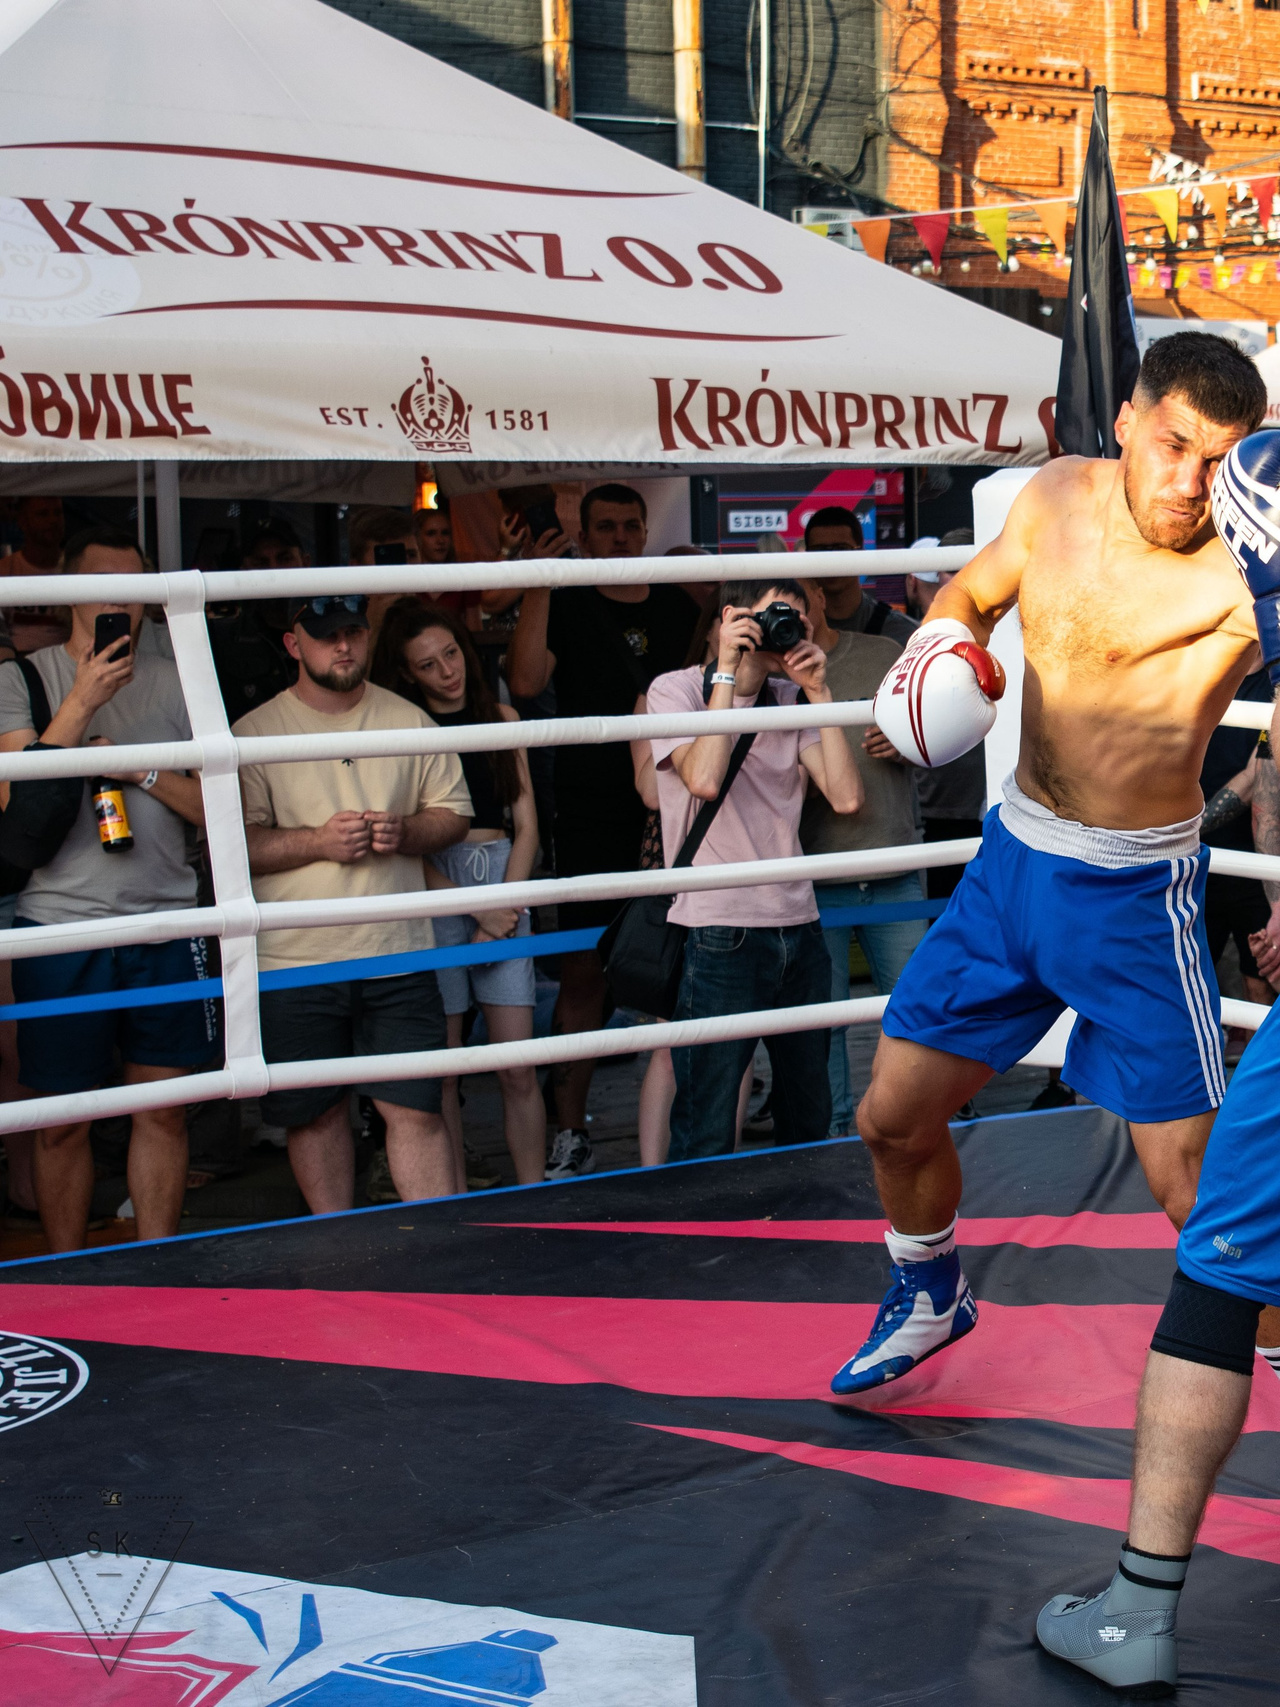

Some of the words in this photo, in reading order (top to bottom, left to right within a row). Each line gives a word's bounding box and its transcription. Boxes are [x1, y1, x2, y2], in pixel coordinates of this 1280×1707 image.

[9, 197, 604, 282] KRÓNPRINZ
[319, 407, 383, 428] EST.
[485, 410, 548, 431] 1581
[649, 369, 1022, 454] KRÓNPRINZ
[733, 515, 784, 528] SIBSA
